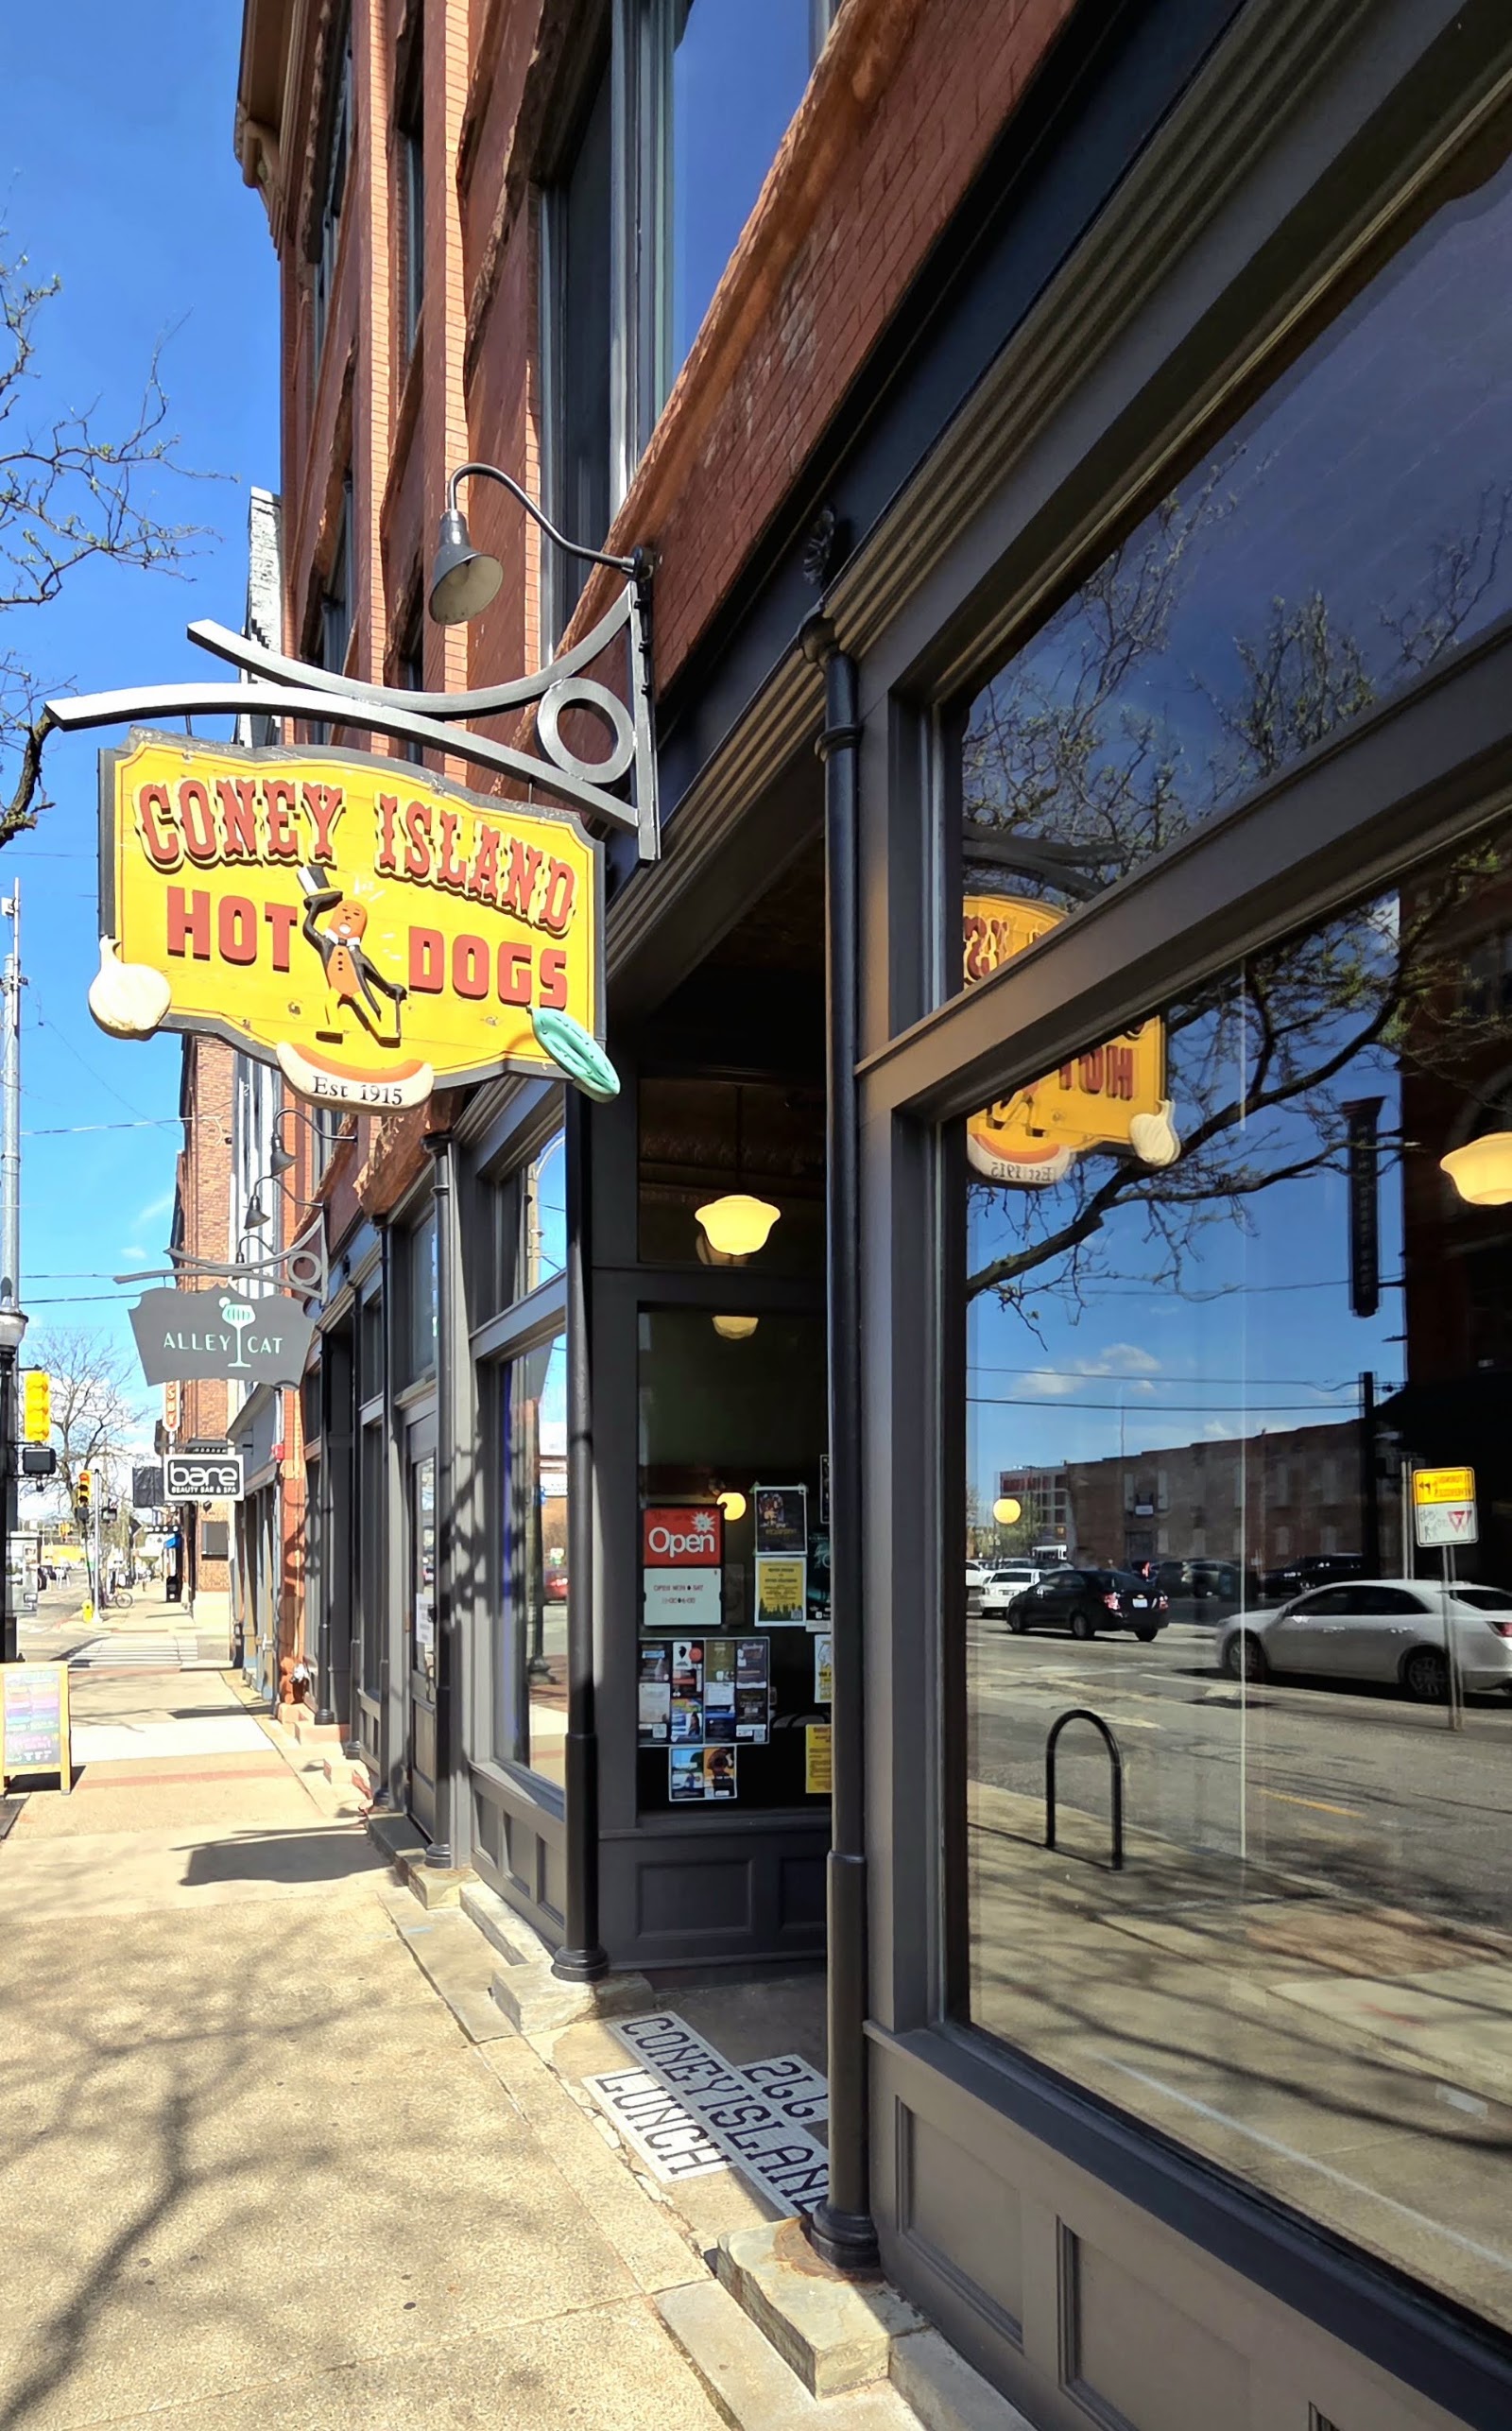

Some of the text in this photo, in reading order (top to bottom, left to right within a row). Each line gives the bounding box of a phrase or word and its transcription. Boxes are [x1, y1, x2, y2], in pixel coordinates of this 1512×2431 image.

[137, 779, 576, 934] CONEY ISLAND
[167, 885, 567, 1010] HOT DOGS
[311, 1076, 403, 1106] Est 1915
[163, 1332, 283, 1353] ALLEY CAT
[170, 1461, 237, 1487] bare
[648, 1526, 714, 1558] Open
[621, 2017, 745, 2095] CONEY
[595, 2069, 732, 2175] LUNCH
